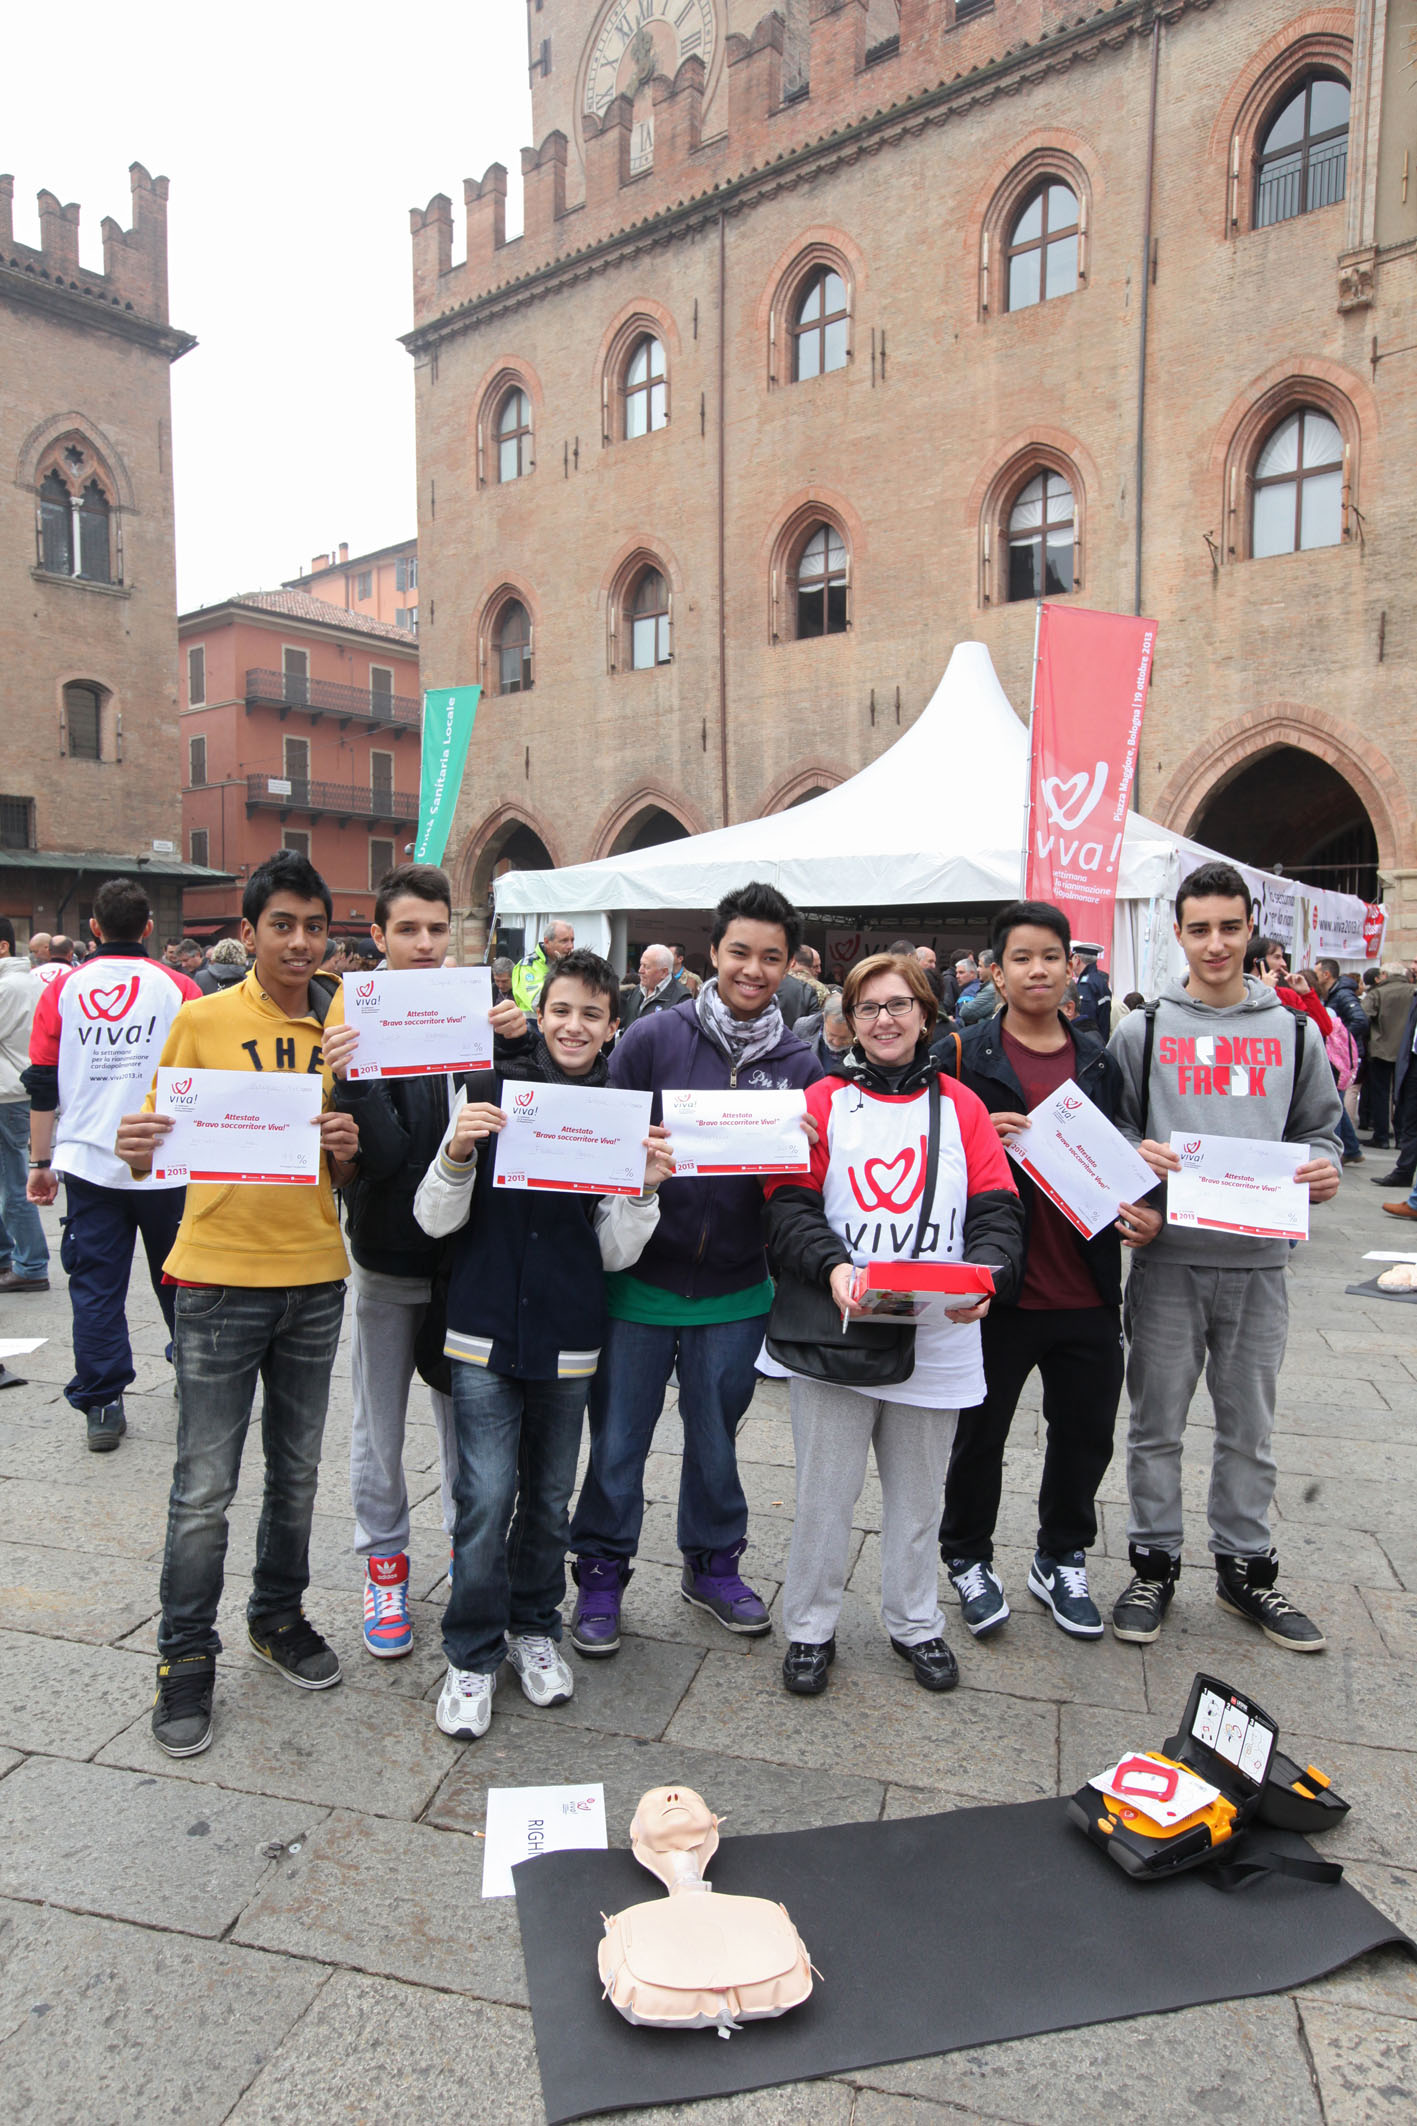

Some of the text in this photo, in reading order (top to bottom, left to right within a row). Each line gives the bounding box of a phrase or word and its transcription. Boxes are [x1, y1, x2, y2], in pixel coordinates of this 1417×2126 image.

[1142, 632, 1153, 654] 2013
[1136, 656, 1149, 691] ottobre
[1134, 692, 1143, 703] 19
[1127, 709, 1142, 746] Bologna
[430, 749, 449, 815] Sanitaria
[443, 697, 456, 745] Locale
[1119, 748, 1136, 790] Maggiore,
[1113, 793, 1127, 822] Piazza
[1053, 869, 1087, 882] ettimana
[1062, 881, 1112, 896] rianimazione
[356, 995, 381, 1006] viva!
[404, 1018, 445, 1026] soccorritore
[78, 1016, 156, 1046] viva!
[90, 1062, 142, 1070] cardiopolmonare
[360, 1064, 378, 1074] 2013
[89, 1072, 143, 1081] www.viva2013.it
[169, 1094, 198, 1105] viva!
[513, 1106, 539, 1116] viva!
[1055, 1101, 1076, 1121] viva!
[224, 1113, 260, 1122] Attestato
[719, 1118, 760, 1126] soccorritore
[220, 1121, 266, 1131] soccorritore
[561, 1126, 594, 1135] Attestato
[557, 1134, 599, 1144] soccorritore
[1010, 1144, 1026, 1158] 2013
[1076, 1144, 1098, 1168] Attestato
[1068, 1147, 1095, 1178] soccorritore
[1180, 1153, 1204, 1162] viva!
[167, 1168, 188, 1176] 2013
[677, 1163, 695, 1171] 2013
[1225, 1172, 1255, 1182] Attestato
[1221, 1180, 1260, 1190] soccorritore
[1179, 1213, 1195, 1221] 2013
[845, 1208, 956, 1253] viva!
